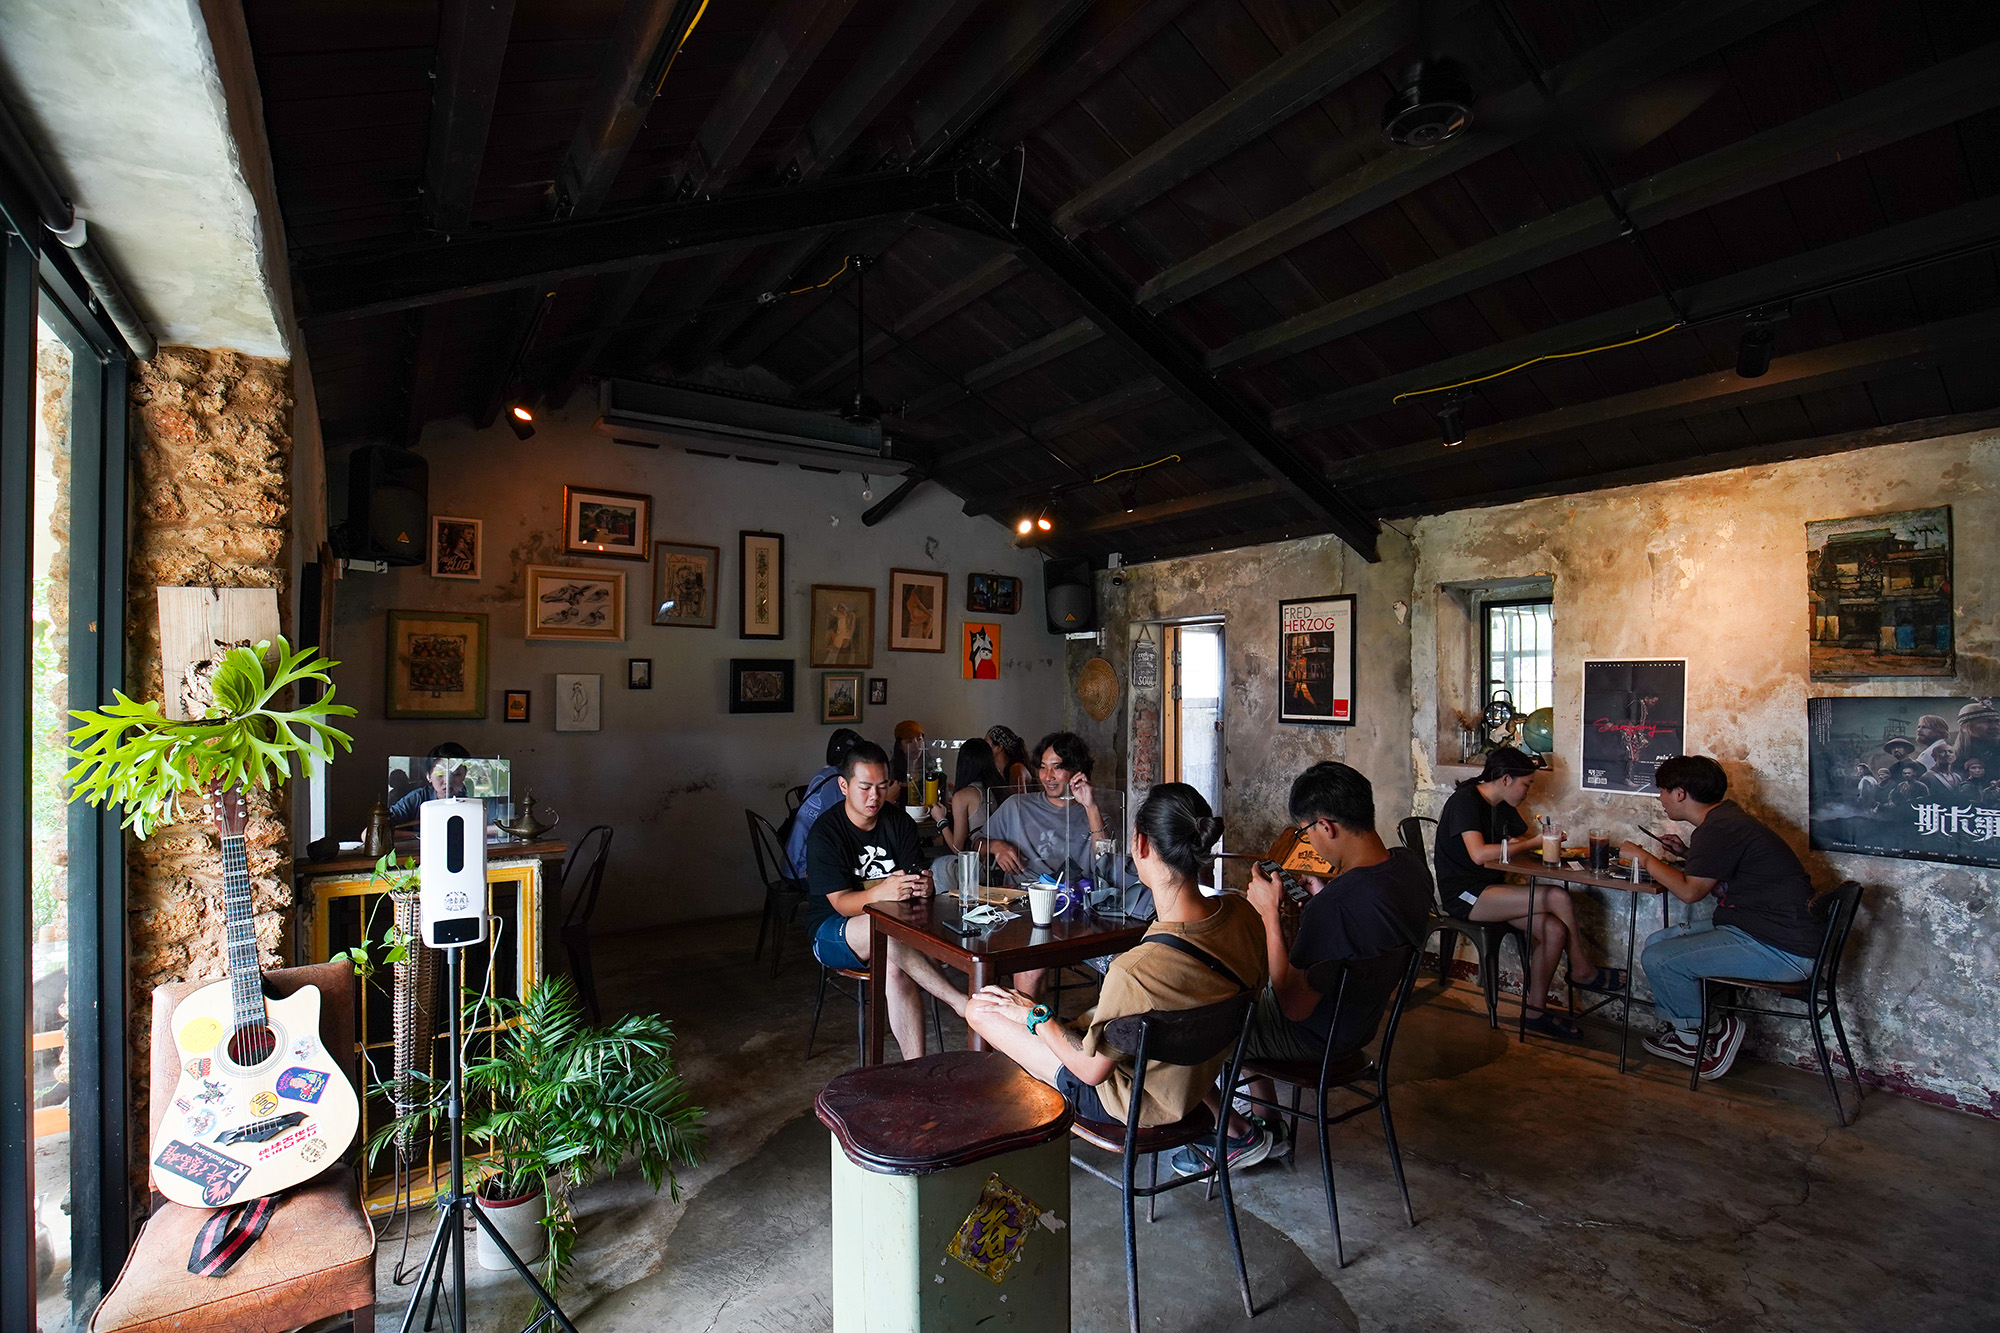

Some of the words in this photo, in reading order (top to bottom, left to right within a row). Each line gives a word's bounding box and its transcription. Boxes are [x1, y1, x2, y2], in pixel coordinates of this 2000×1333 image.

[1284, 606, 1312, 619] FRED
[1284, 617, 1335, 632] HERZOG
[1138, 676, 1154, 686] SOUL
[161, 1145, 227, 1184] 光復高雄
[976, 1197, 1021, 1260] 春
